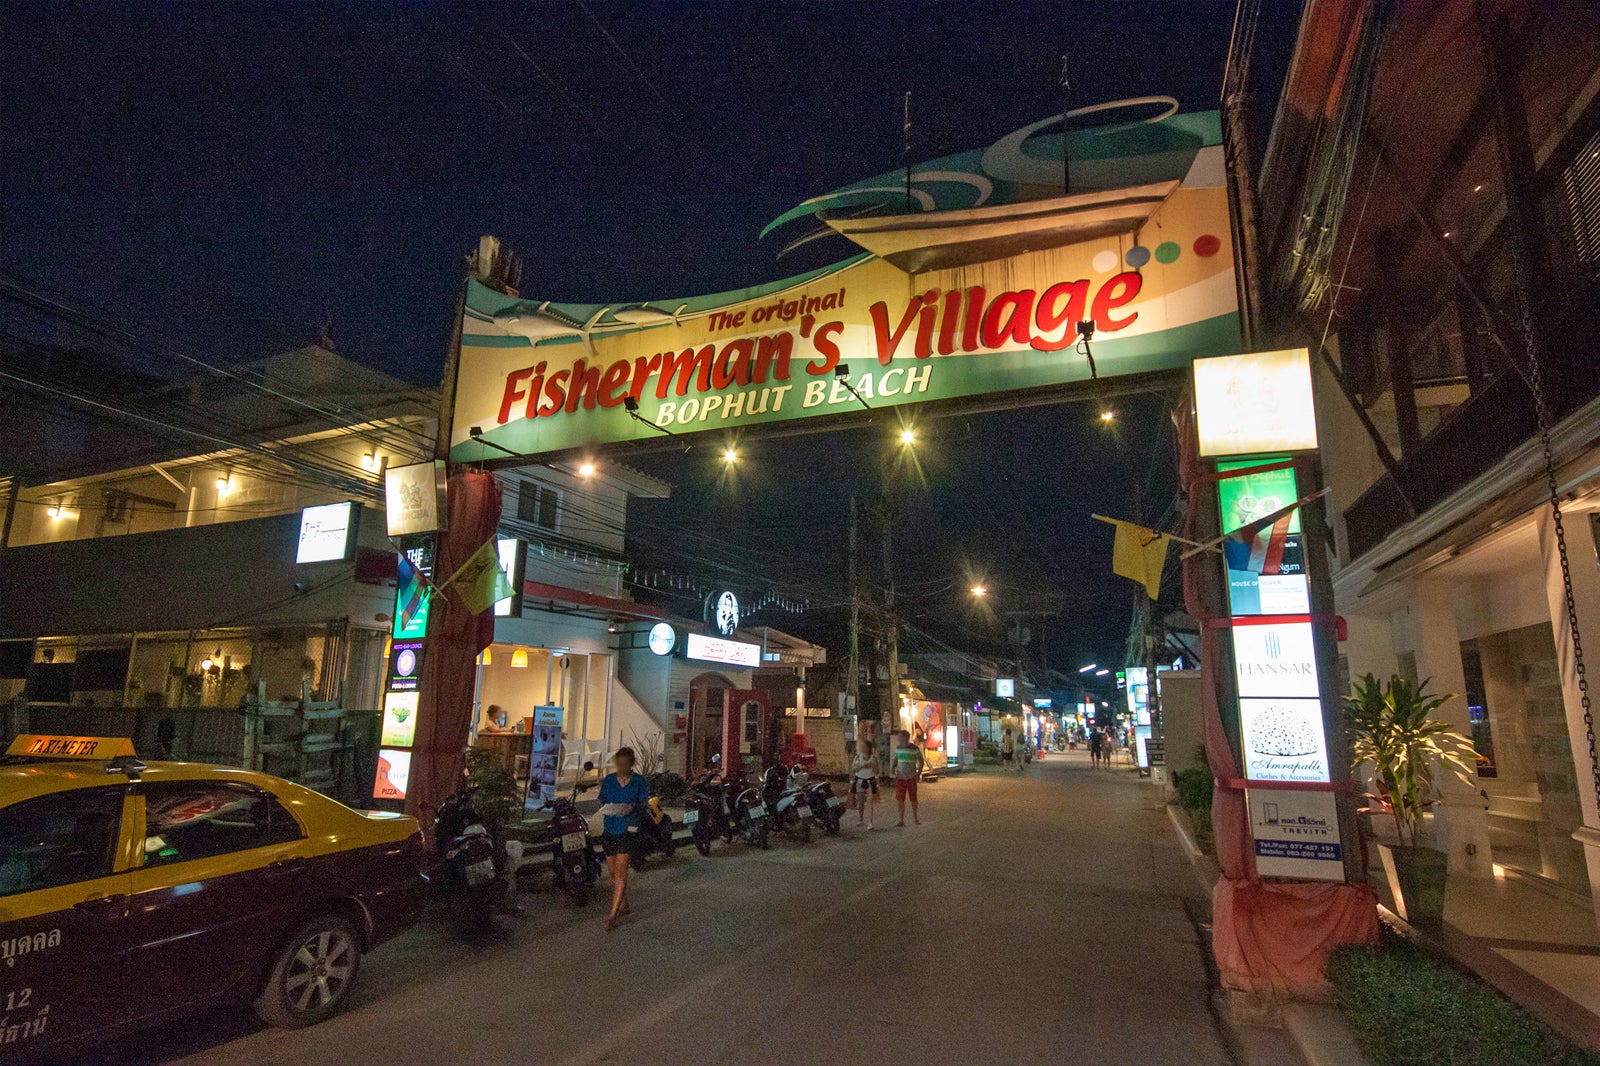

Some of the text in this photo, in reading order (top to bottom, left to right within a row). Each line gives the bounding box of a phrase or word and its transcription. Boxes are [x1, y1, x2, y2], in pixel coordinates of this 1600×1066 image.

[709, 288, 846, 333] The original
[497, 271, 1144, 426] Fisherman's Village
[655, 364, 935, 428] BOPHUT BEACH
[1239, 663, 1312, 675] HANSAR
[30, 739, 99, 756] TAXI-METER
[1251, 757, 1323, 775] Amrapalli
[1256, 772, 1278, 780] Clothes
[1289, 773, 1321, 781] Accessories
[381, 788, 398, 796] PIZZA
[1283, 827, 1327, 835] TREVITH
[5, 987, 33, 1011] 12
